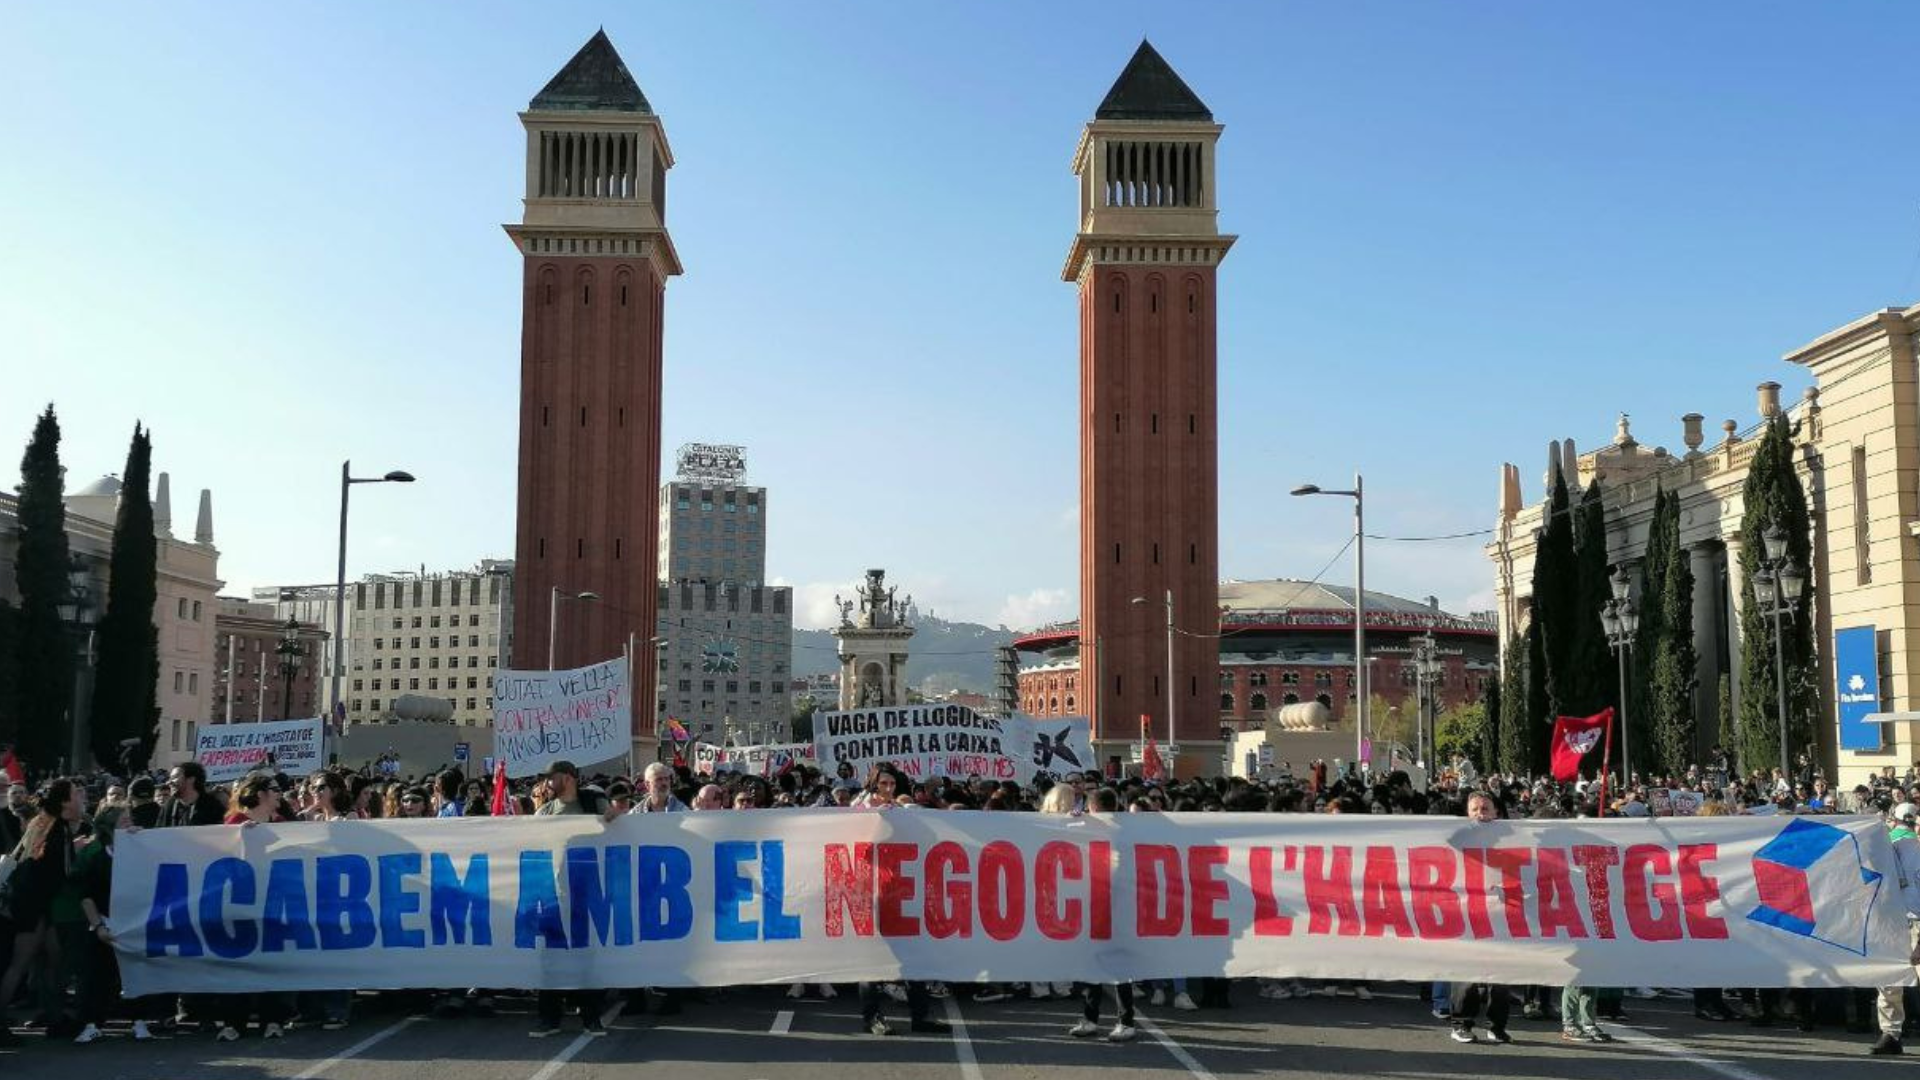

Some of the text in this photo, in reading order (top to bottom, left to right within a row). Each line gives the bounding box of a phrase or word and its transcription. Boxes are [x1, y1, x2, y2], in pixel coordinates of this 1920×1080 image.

[687, 456, 745, 469] PLAZA
[496, 677, 548, 701] CIUTAT
[827, 712, 879, 736] VAGA
[884, 709, 913, 731] DE
[200, 735, 218, 748] PEL
[833, 731, 1003, 762] CONTRA LA CAIXA
[146, 840, 1730, 959] ACABEM AMB EL NEGOCI DE L'HABITATGE
